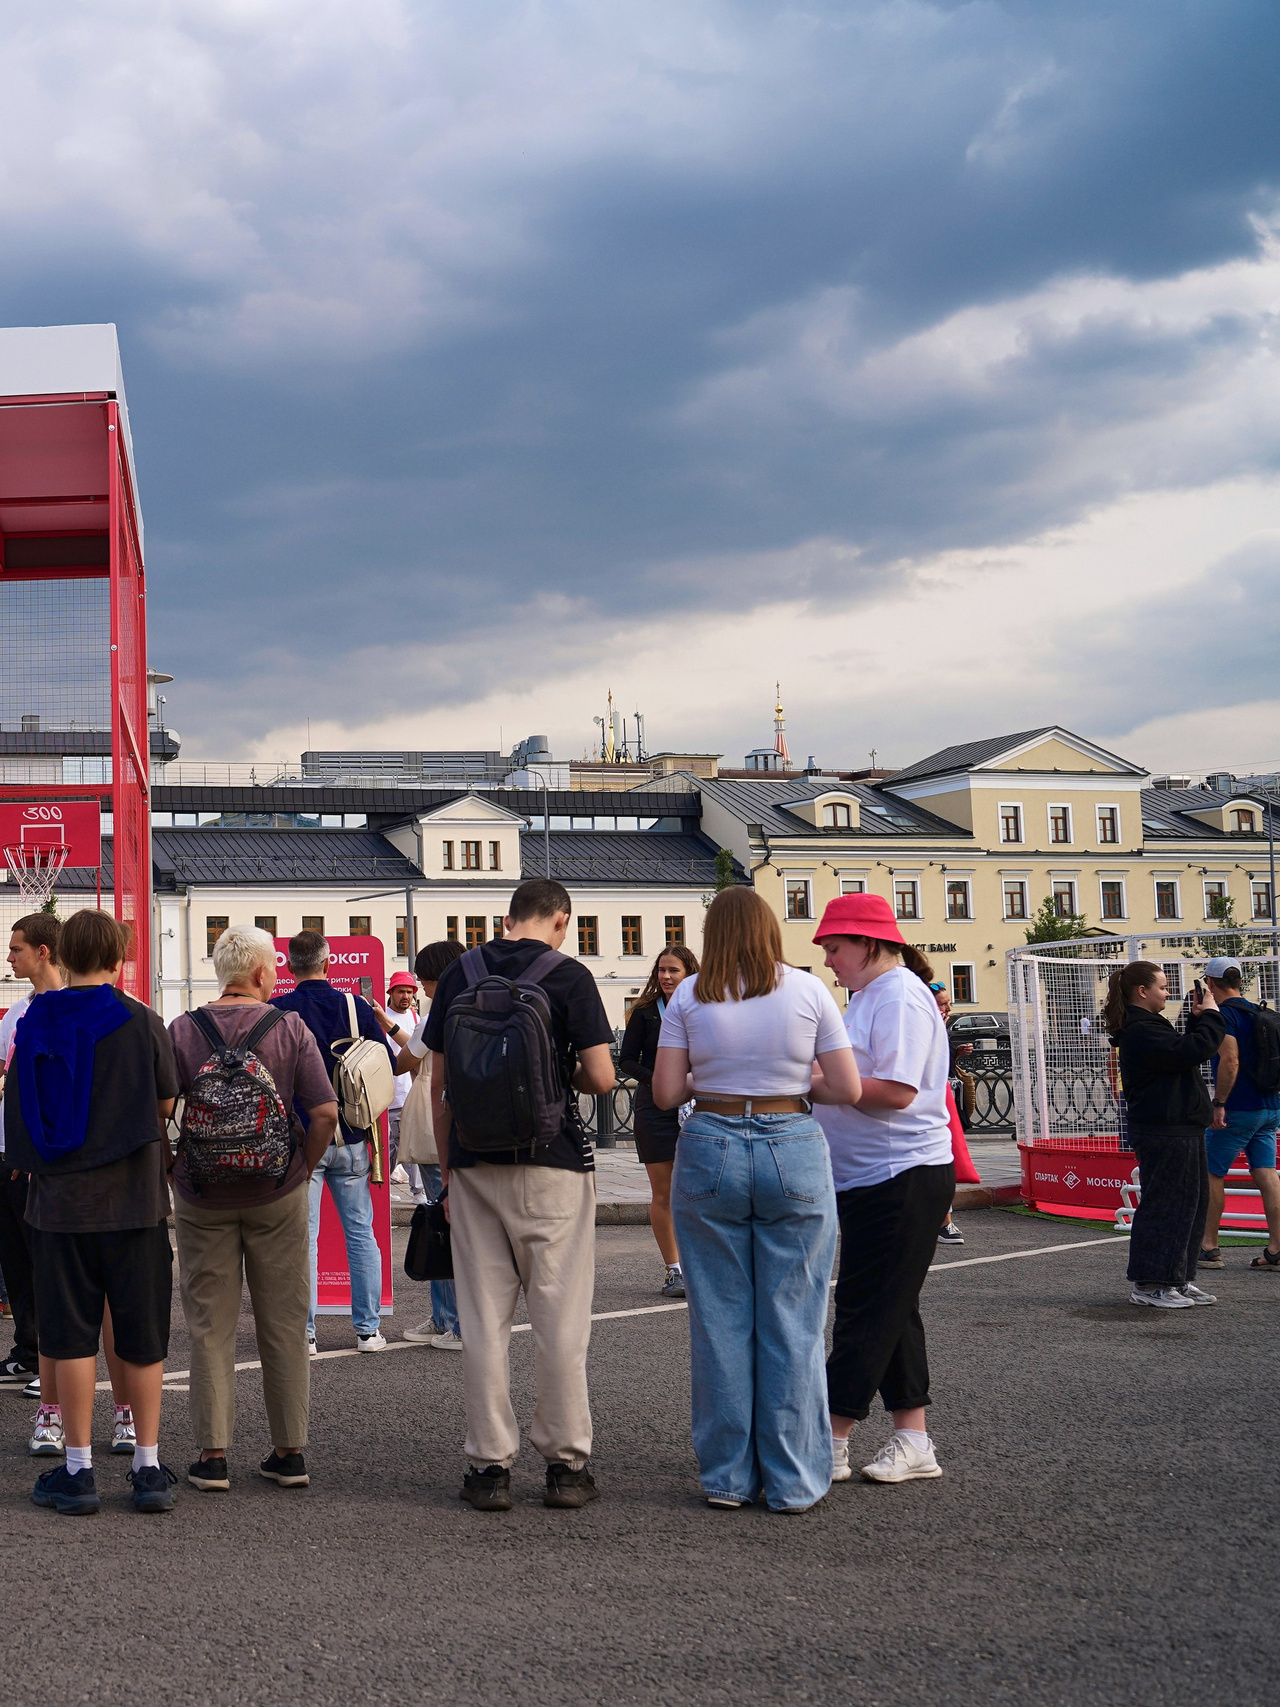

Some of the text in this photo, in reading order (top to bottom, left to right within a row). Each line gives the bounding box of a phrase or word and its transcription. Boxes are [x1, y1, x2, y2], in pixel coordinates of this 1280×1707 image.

[22, 806, 63, 820] 300
[929, 943, 957, 952] БАНК
[328, 952, 370, 965] окат
[1034, 1171, 1059, 1183] СПАРТАК
[1086, 1177, 1128, 1188] МОСКВА
